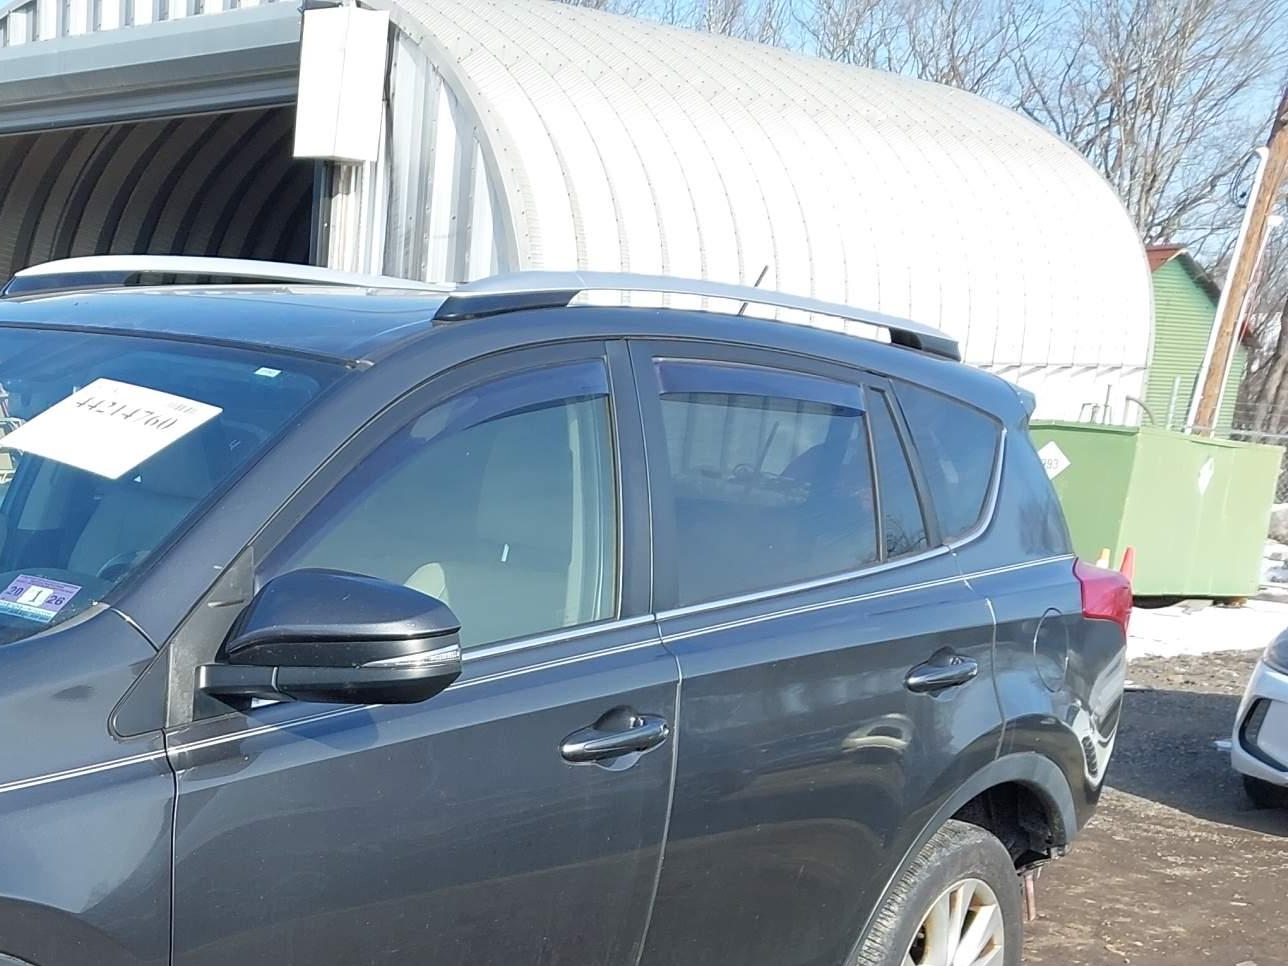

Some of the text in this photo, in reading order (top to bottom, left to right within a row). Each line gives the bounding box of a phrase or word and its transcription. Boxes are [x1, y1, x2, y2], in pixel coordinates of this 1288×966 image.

[76, 397, 178, 430] 44214760
[8, 586, 24, 597] 20
[47, 595, 66, 606] 26
